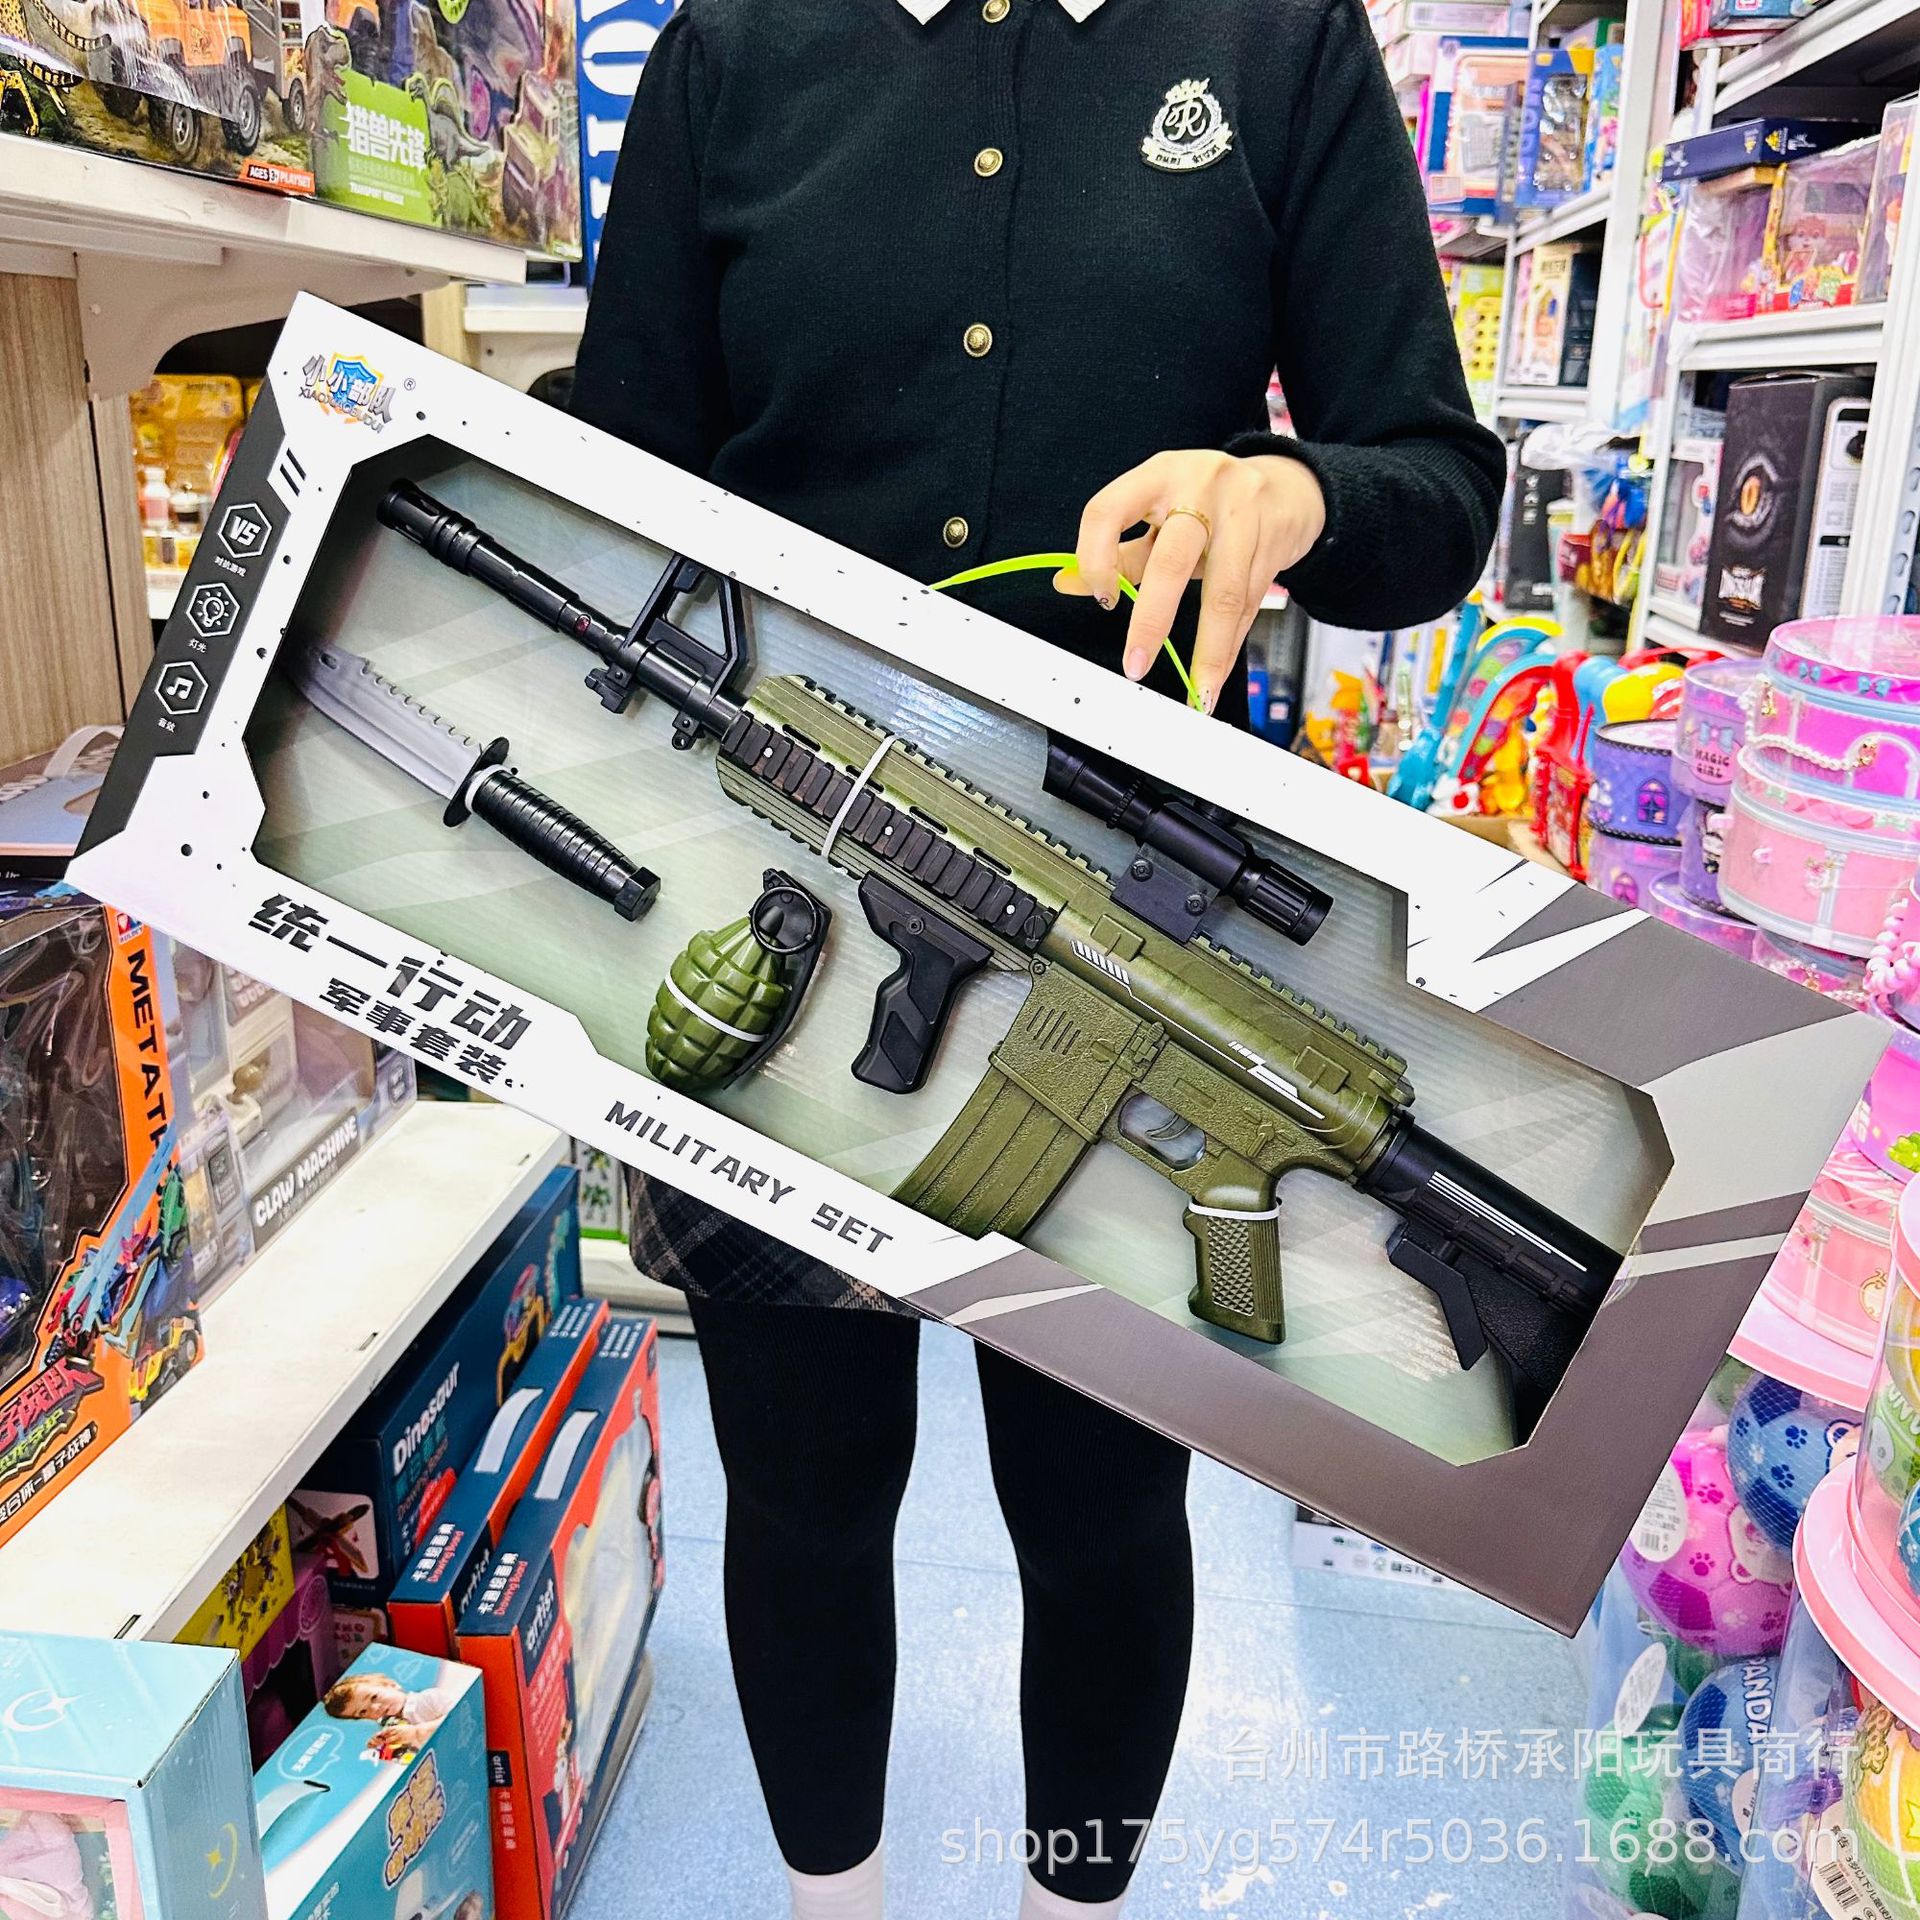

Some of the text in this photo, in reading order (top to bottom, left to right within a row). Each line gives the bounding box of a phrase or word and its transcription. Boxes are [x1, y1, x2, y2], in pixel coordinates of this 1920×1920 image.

[250, 166, 269, 181] AGES
[303, 354, 396, 424] 小小部队
[230, 516, 261, 546] VS
[214, 556, 247, 577] 对抗游戏
[188, 638, 207, 653] 灯光
[157, 717, 176, 733] 音效
[1695, 749, 1730, 767] MAGIC
[1696, 763, 1723, 778] GIRL
[248, 893, 532, 1051] 统一行动
[319, 977, 506, 1085] 军事套装
[253, 1172, 296, 1228] CLAW
[296, 1114, 359, 1190] MACHINE
[604, 1100, 894, 1254] MILITARY SET
[393, 1361, 460, 1476] Dinosaur
[494, 1580, 521, 1616] Drawing
[527, 1577, 554, 1651] artist
[492, 1755, 506, 1785] artist
